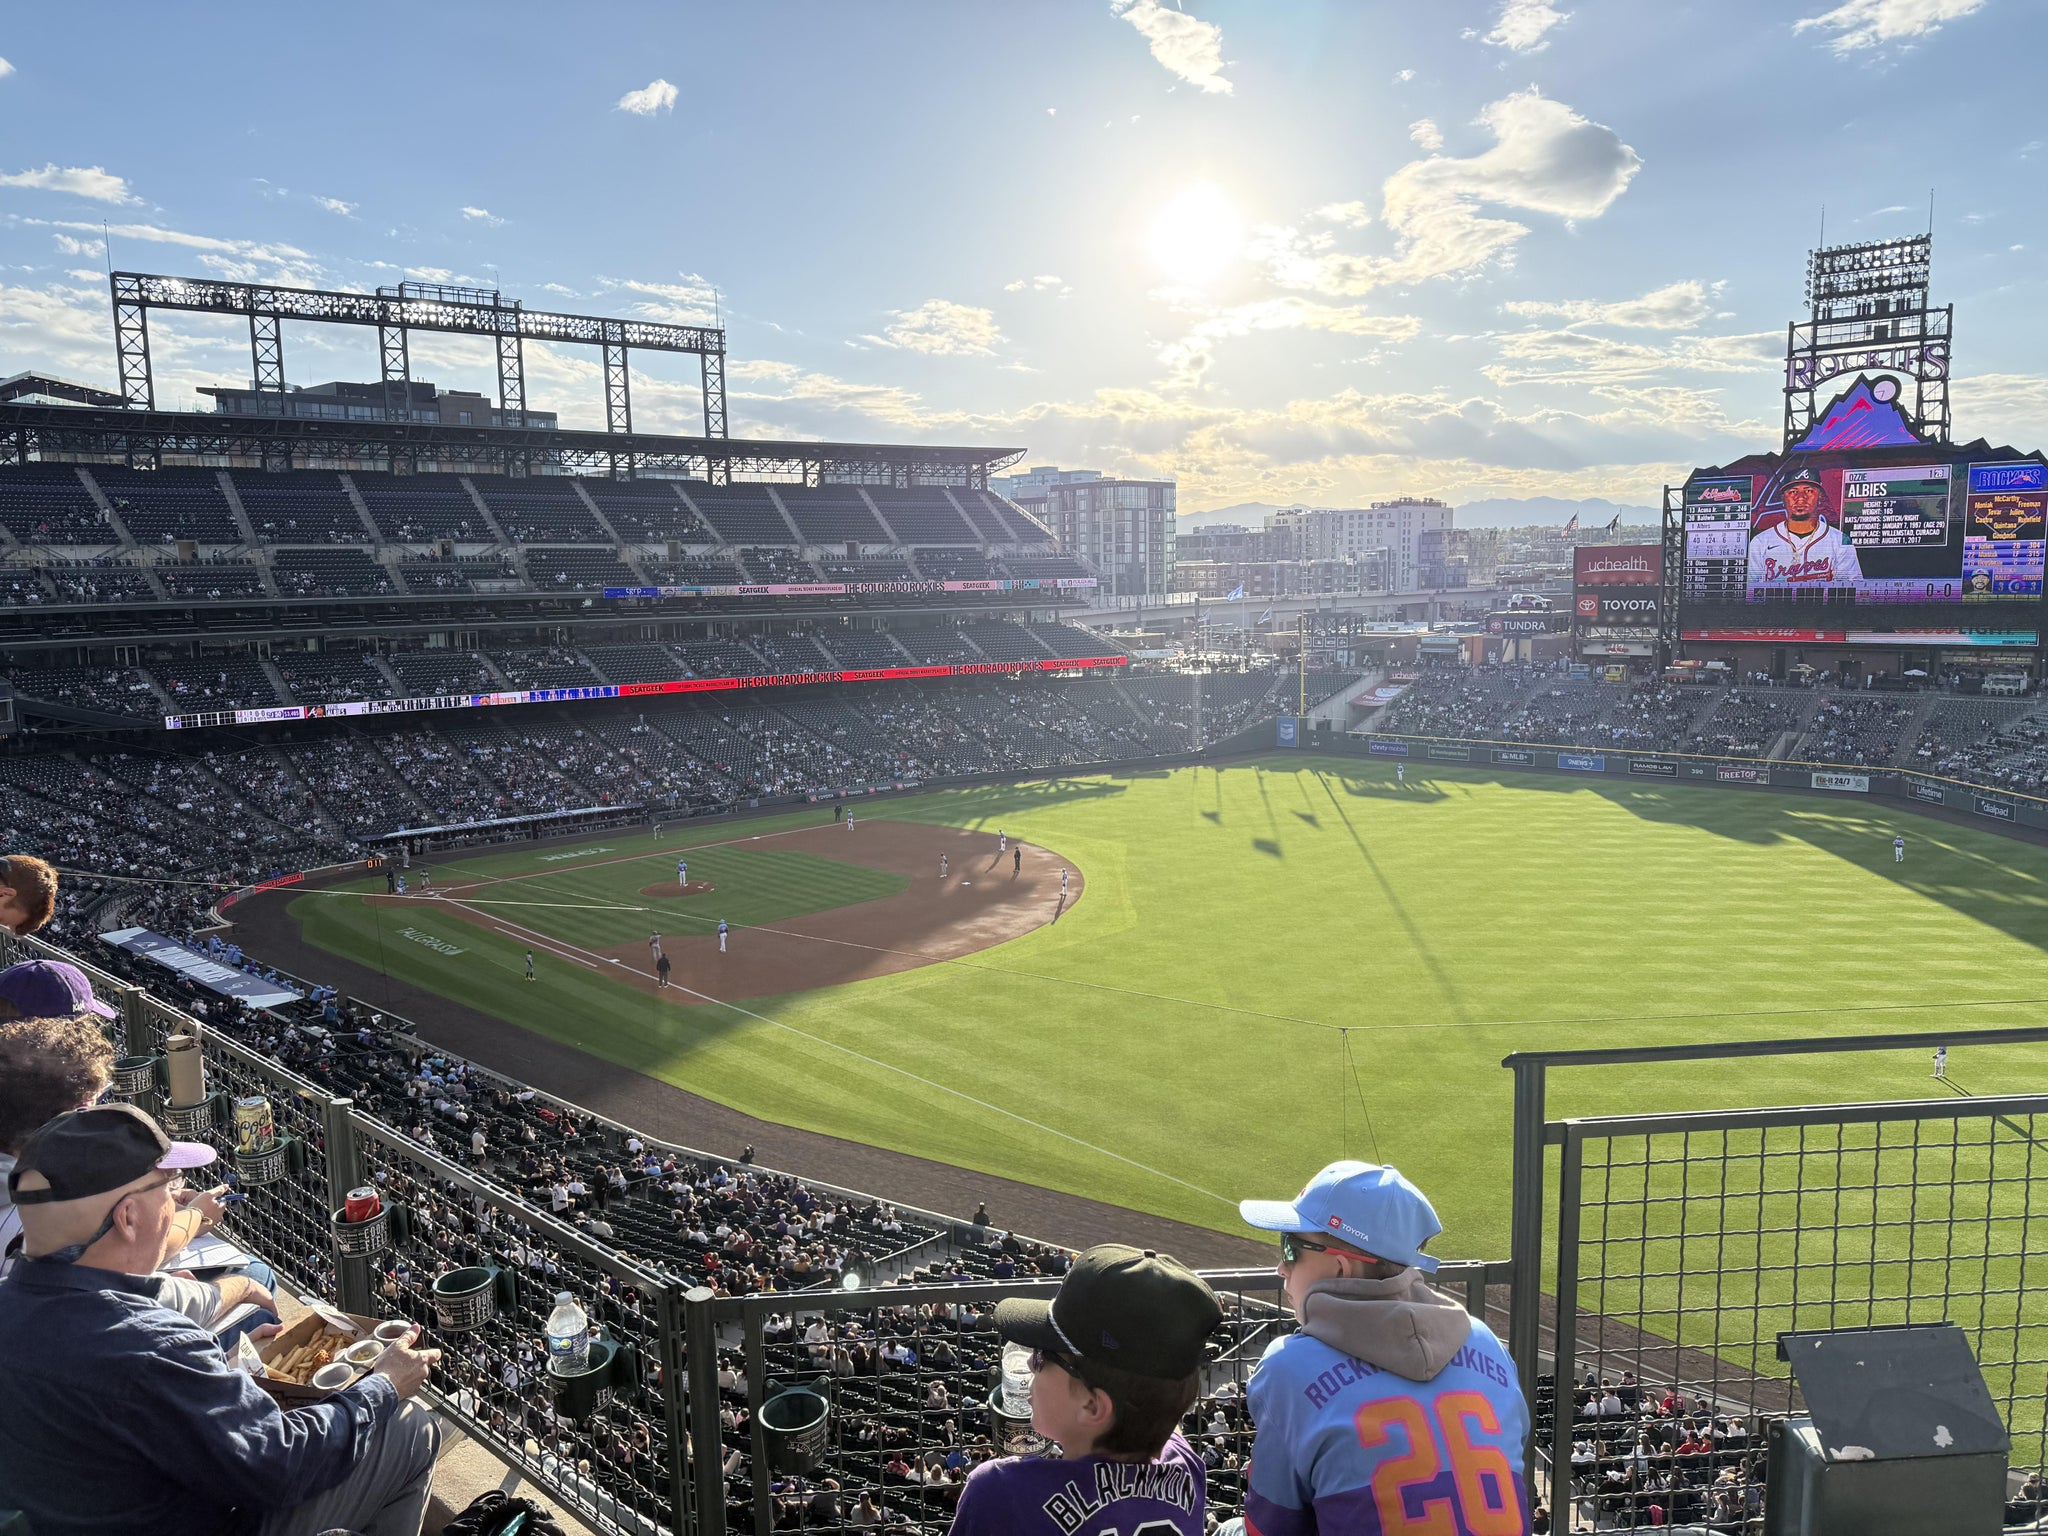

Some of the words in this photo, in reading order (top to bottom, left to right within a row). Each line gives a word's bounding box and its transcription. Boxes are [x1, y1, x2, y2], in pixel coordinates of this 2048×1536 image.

[1849, 473, 1867, 482] OZZIE
[1978, 469, 2042, 487] ROCKIES
[1848, 483, 1887, 497] ALBIES
[1994, 496, 2020, 504] McCarthy
[1588, 556, 1648, 572] uchealth
[1764, 556, 1831, 581] Braves
[844, 584, 860, 594] THE
[860, 581, 909, 593] COLORADO
[909, 581, 945, 592] ROCKIES
[1603, 600, 1656, 610] TOYOTA
[1504, 621, 1546, 630] TUNDRA
[950, 664, 963, 675] THE
[964, 662, 1010, 674] COLORADO
[1010, 660, 1044, 672] ROCKIES
[1052, 660, 1079, 668] SEATGEEK
[1093, 657, 1121, 666] SEATGEEK
[738, 677, 753, 688] THE
[754, 674, 802, 688] COLORADO
[804, 672, 842, 684] ROCKIES
[630, 684, 664, 694] SEATGEEK
[1834, 777, 1850, 785] 24/7
[1916, 786, 1942, 798] Lifetime
[1984, 804, 2008, 816] dialpad
[191, 1116, 212, 1131] FIELD
[263, 1165, 285, 1182] FIELD
[1342, 1223, 1370, 1242] TOYOTA
[365, 1232, 388, 1251] FIELD
[470, 1303, 494, 1324] FIELD
[1006, 1430, 1044, 1442] COLORADO
[1005, 1442, 1045, 1452] ROCKIES
[1354, 1390, 1524, 1536] 26
[1042, 1462, 1198, 1536] BLACKMON
